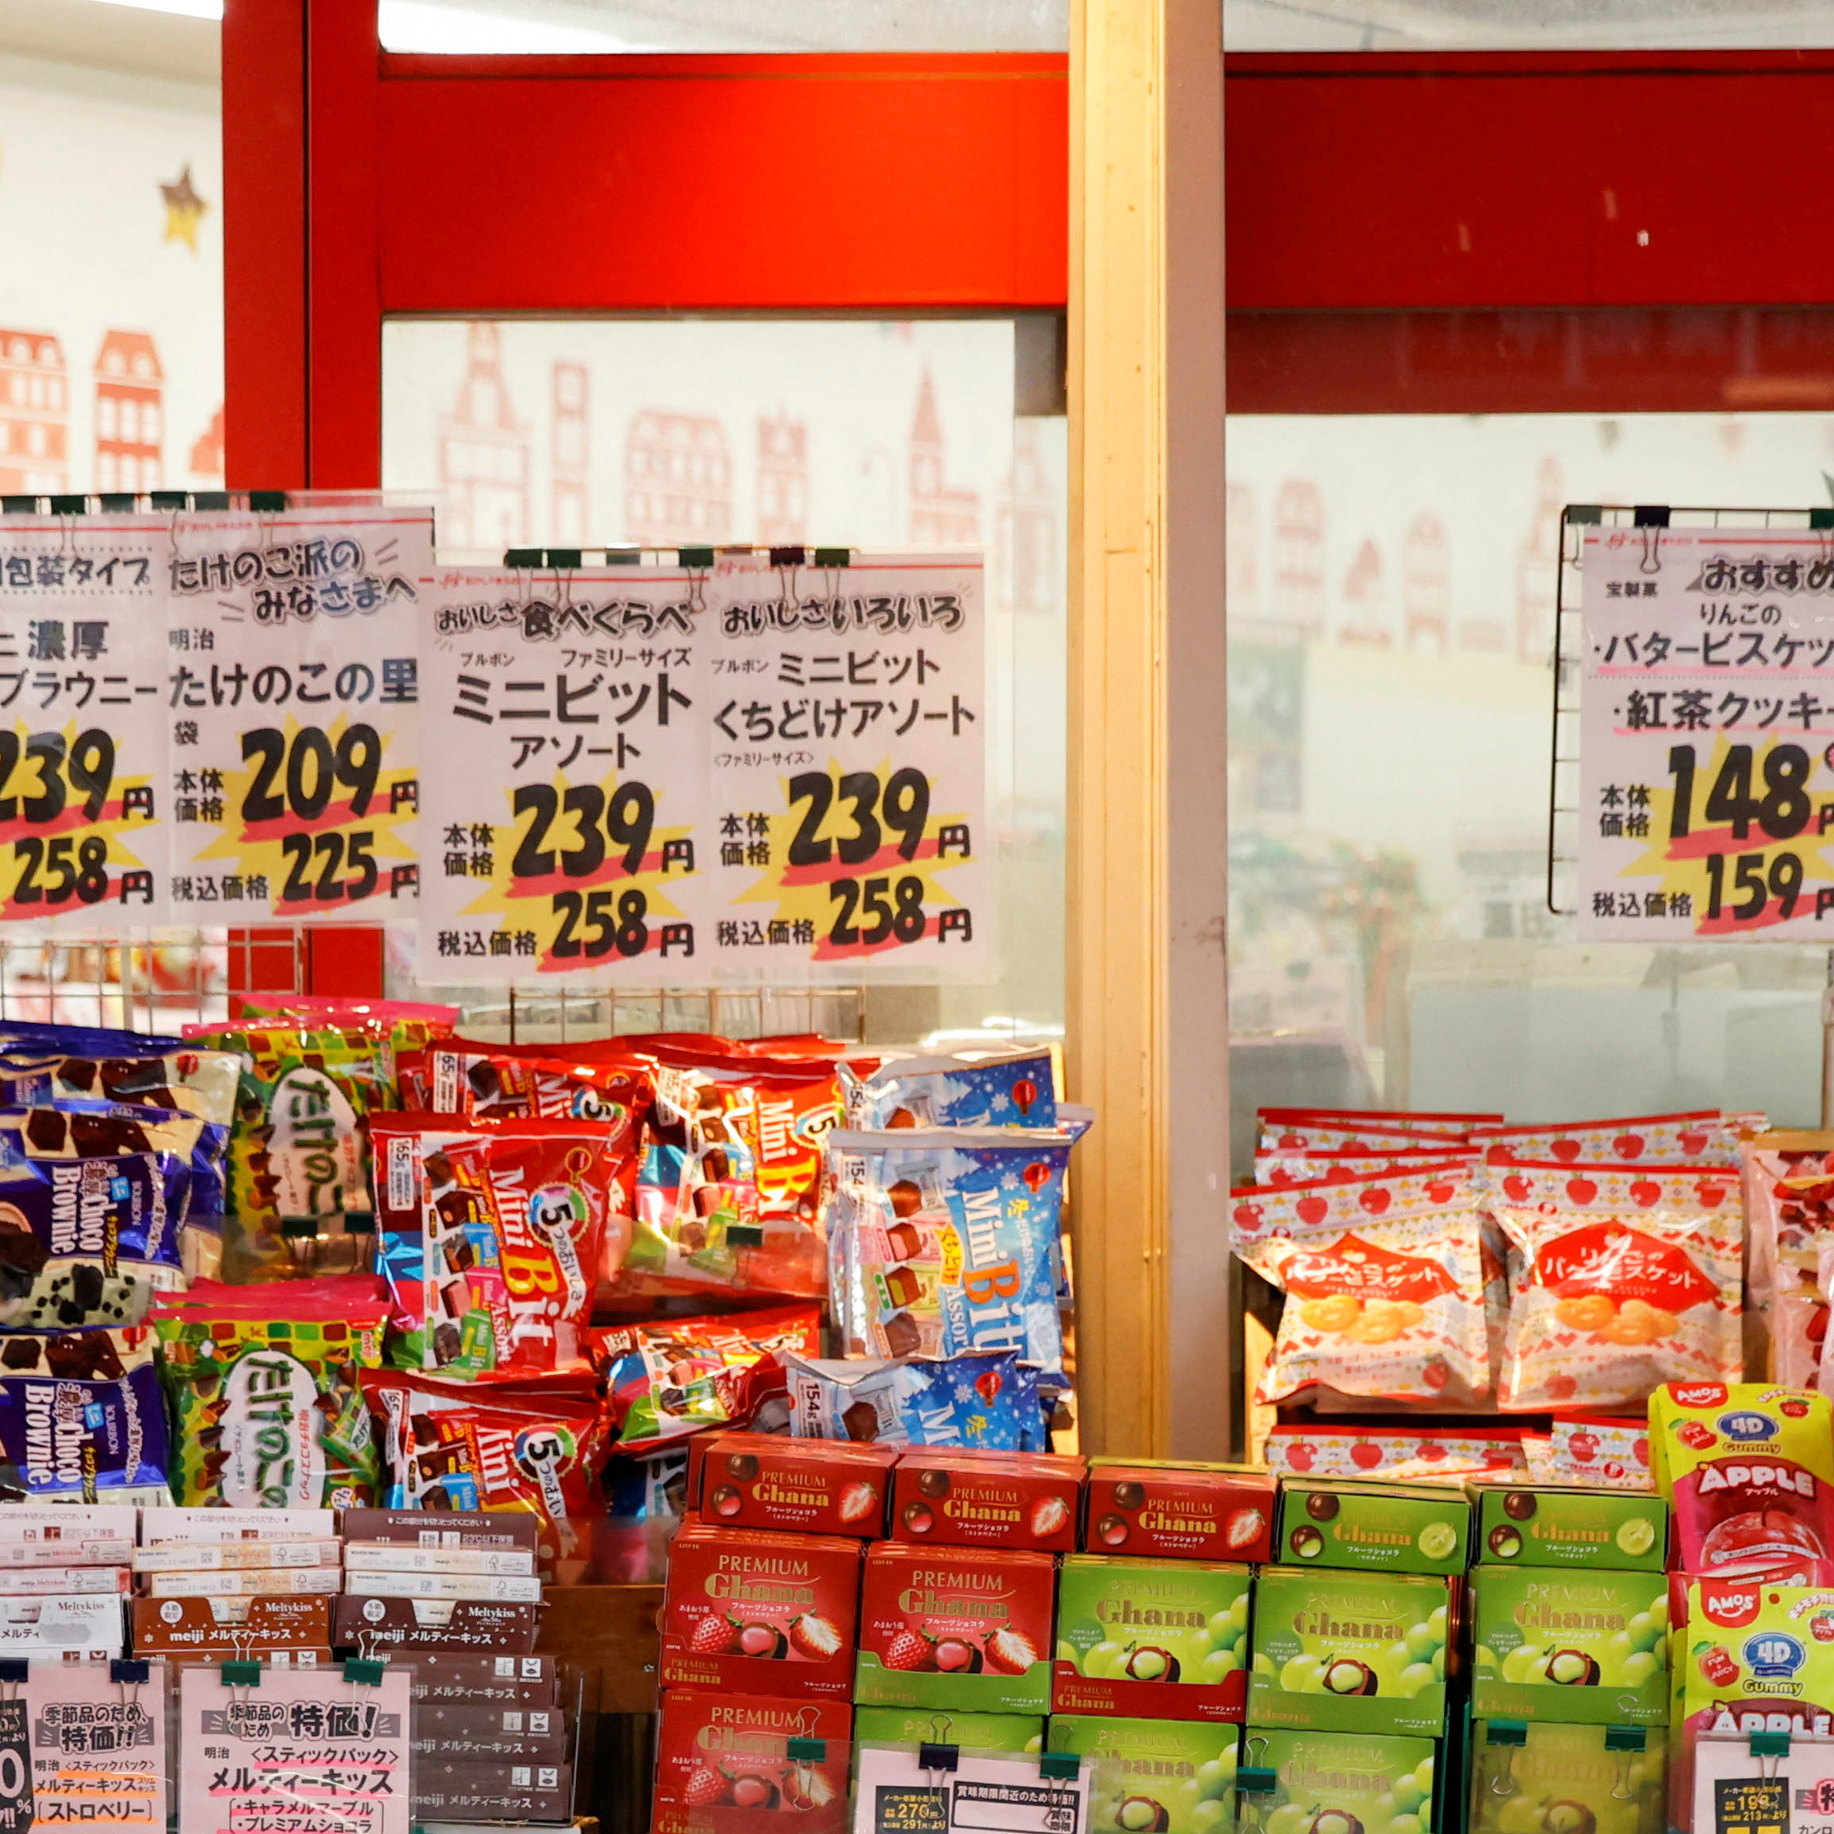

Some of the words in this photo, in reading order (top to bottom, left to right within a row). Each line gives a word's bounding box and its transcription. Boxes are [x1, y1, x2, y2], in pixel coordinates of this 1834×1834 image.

[169, 540, 359, 591] たけのこ派の
[251, 576, 417, 621] みなさまへ
[439, 601, 691, 637] おいしさ食べくらべ
[723, 595, 963, 635] おいしさいろいろ
[1699, 601, 1782, 627] りんごの
[561, 647, 692, 668] ファミリーサイズ
[777, 648, 939, 687] ミニビット
[169, 657, 418, 707] たけのこの里
[453, 672, 692, 728] ミニビット
[713, 695, 975, 743] くちどけアソート
[510, 733, 640, 770] アソート
[1677, 1387, 1721, 1402] AMOS
[1698, 1462, 1815, 1498] APPLE
[953, 1487, 1018, 1503] PREMIUM
[943, 1499, 1021, 1523] Ghana
[718, 1555, 809, 1576] PREMIUM
[704, 1572, 815, 1605] Ghana
[912, 1570, 1003, 1590] PREMIUM
[58, 1601, 105, 1613] Meltykiss
[265, 1601, 313, 1614] Meltykiss
[898, 1588, 1009, 1619] Ghana
[1708, 1593, 1756, 1613] AMOS
[1742, 1679, 1806, 1696] Gummy
[208, 1769, 393, 1795] メルティーキッス
